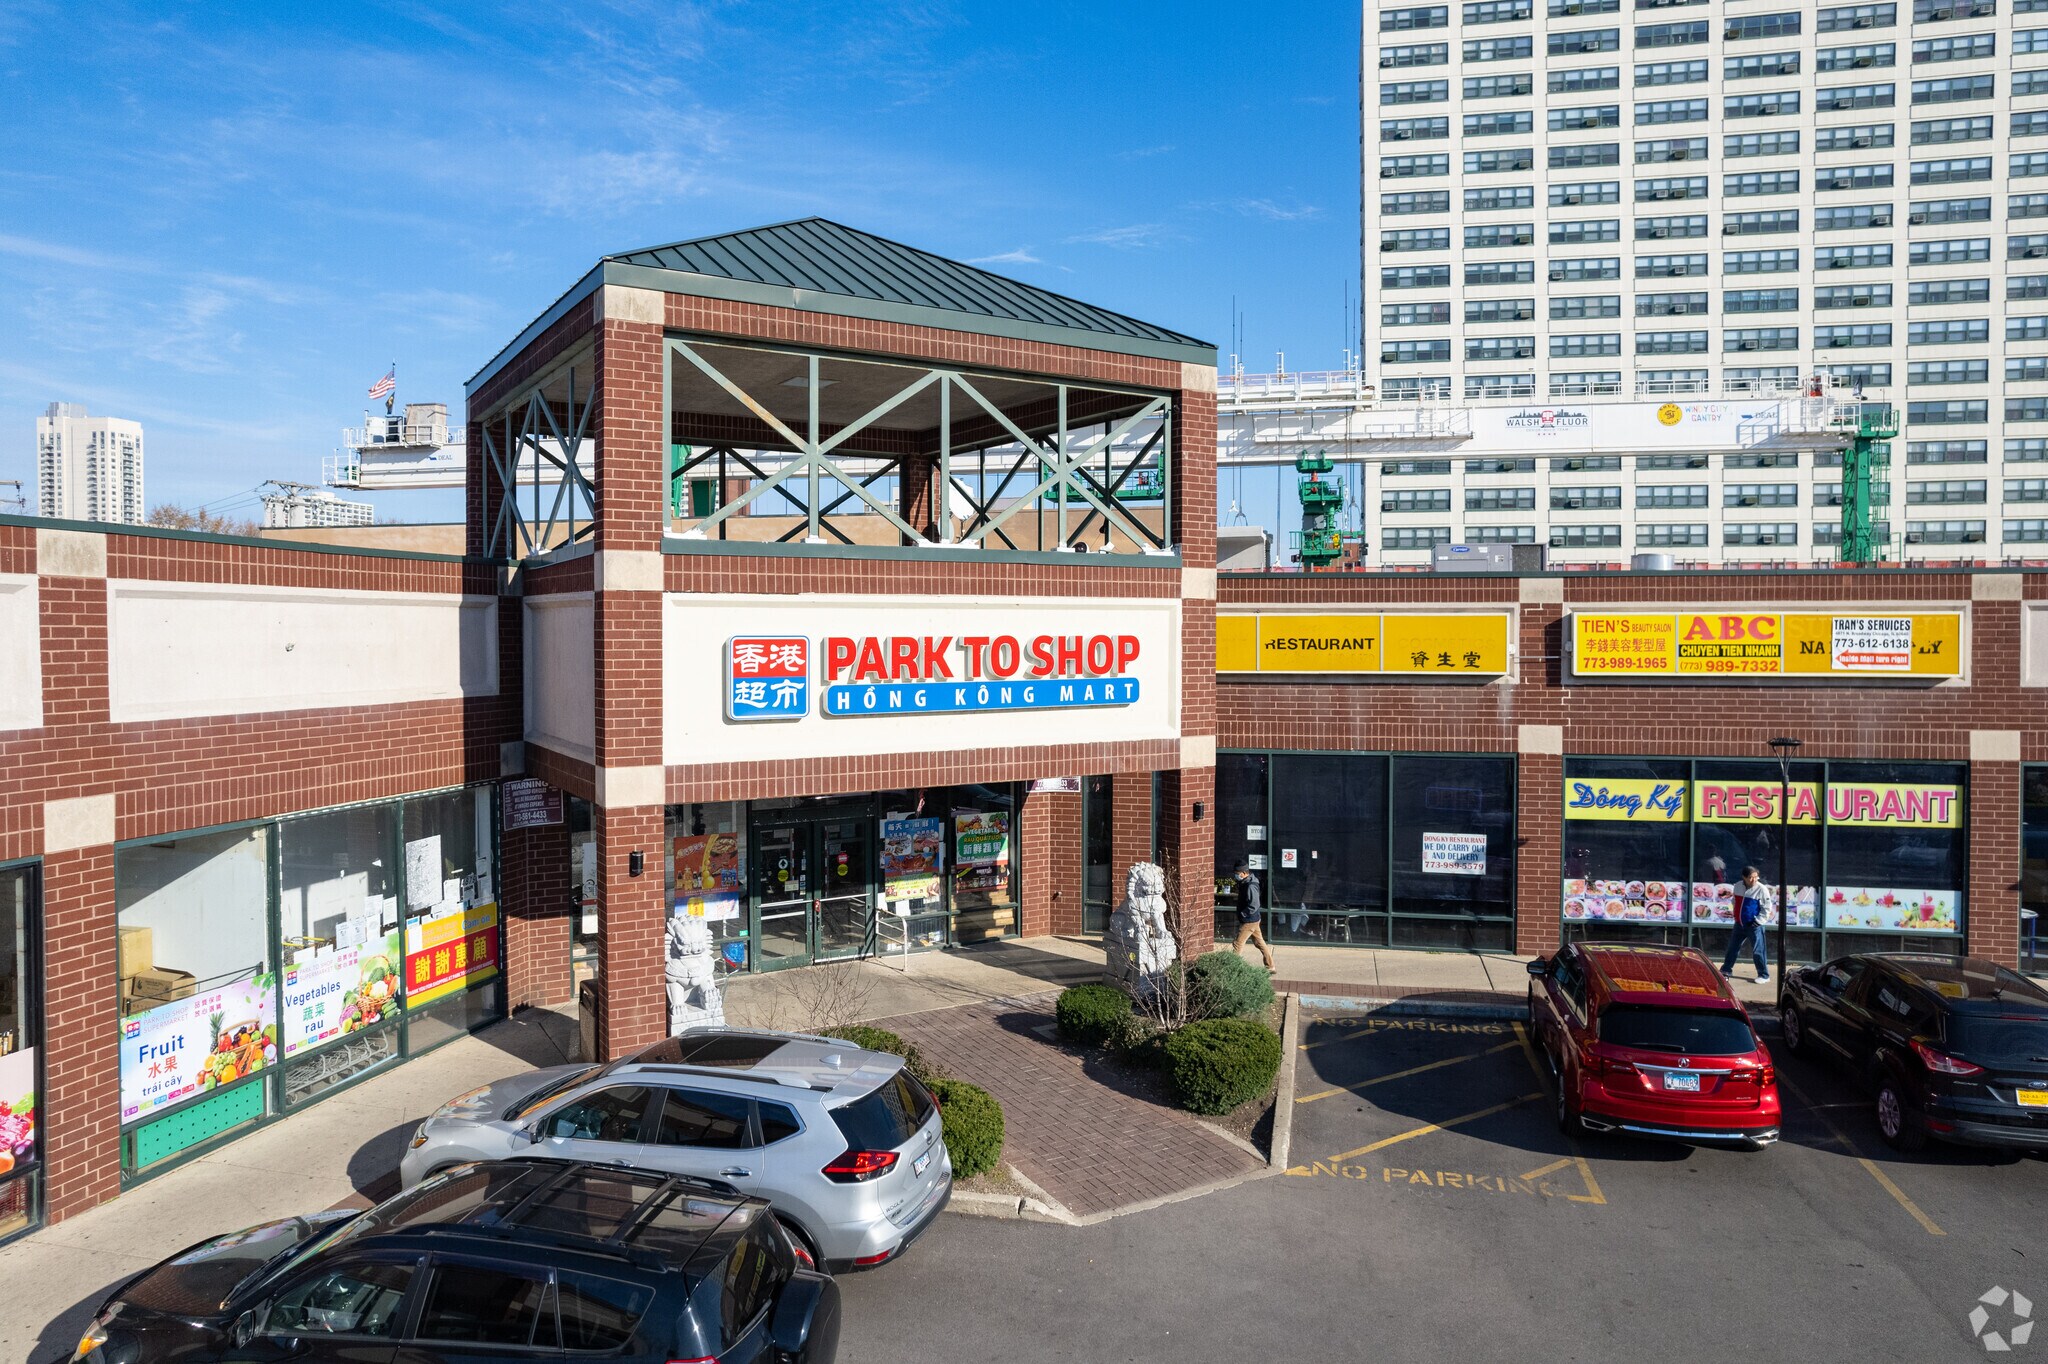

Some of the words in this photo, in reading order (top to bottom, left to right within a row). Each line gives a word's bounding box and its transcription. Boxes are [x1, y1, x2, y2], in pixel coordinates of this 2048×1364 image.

[1506, 418, 1540, 427] WALSH
[1556, 417, 1588, 426] FLUOR
[1691, 414, 1721, 422] GANTRY
[1582, 620, 1630, 633] TIEN'S
[1632, 623, 1653, 633] BEAUTY
[1653, 623, 1672, 632] SALON
[1683, 616, 1776, 641] ABC
[1834, 619, 1864, 631] TRAN'S
[1867, 619, 1911, 631] SERVICES
[1834, 638, 1909, 648] 773-612-6138
[1680, 645, 1721, 657] CHUYEN
[1722, 645, 1743, 657] TIEN
[1746, 645, 1779, 657] NHANH
[733, 644, 806, 673] 香港
[828, 636, 954, 681] PARK
[963, 635, 1020, 678] TO
[1031, 635, 1140, 677] SHOP
[1583, 657, 1668, 669] 773-989-1965
[1680, 660, 1703, 671] (773)
[1706, 660, 1779, 672] 989-7332
[733, 678, 805, 709] 超市
[955, 684, 1035, 706] KÔNG
[1060, 683, 1133, 702] MART
[511, 780, 549, 791] WARNING
[1449, 836, 1485, 844] RESTAURANT
[1436, 843, 1446, 851] DO
[1447, 843, 1470, 852] CARRY
[1471, 844, 1485, 852] OUT
[1432, 852, 1446, 860] AND
[1447, 852, 1479, 861] DELIVERY
[1425, 861, 1484, 870] 773-989-5579
[415, 936, 487, 984] 謝謝惠顧
[285, 981, 341, 1007] Vegetables
[303, 1002, 325, 1021] 蔬菜
[305, 1020, 324, 1033] rau
[1314, 1017, 1358, 1028] NO
[1368, 1018, 1504, 1036] PARKING
[139, 1033, 185, 1063] Fruit
[148, 1056, 178, 1079] 水果
[1311, 1161, 1367, 1180] NO
[1383, 1167, 1563, 1197] PARKING
